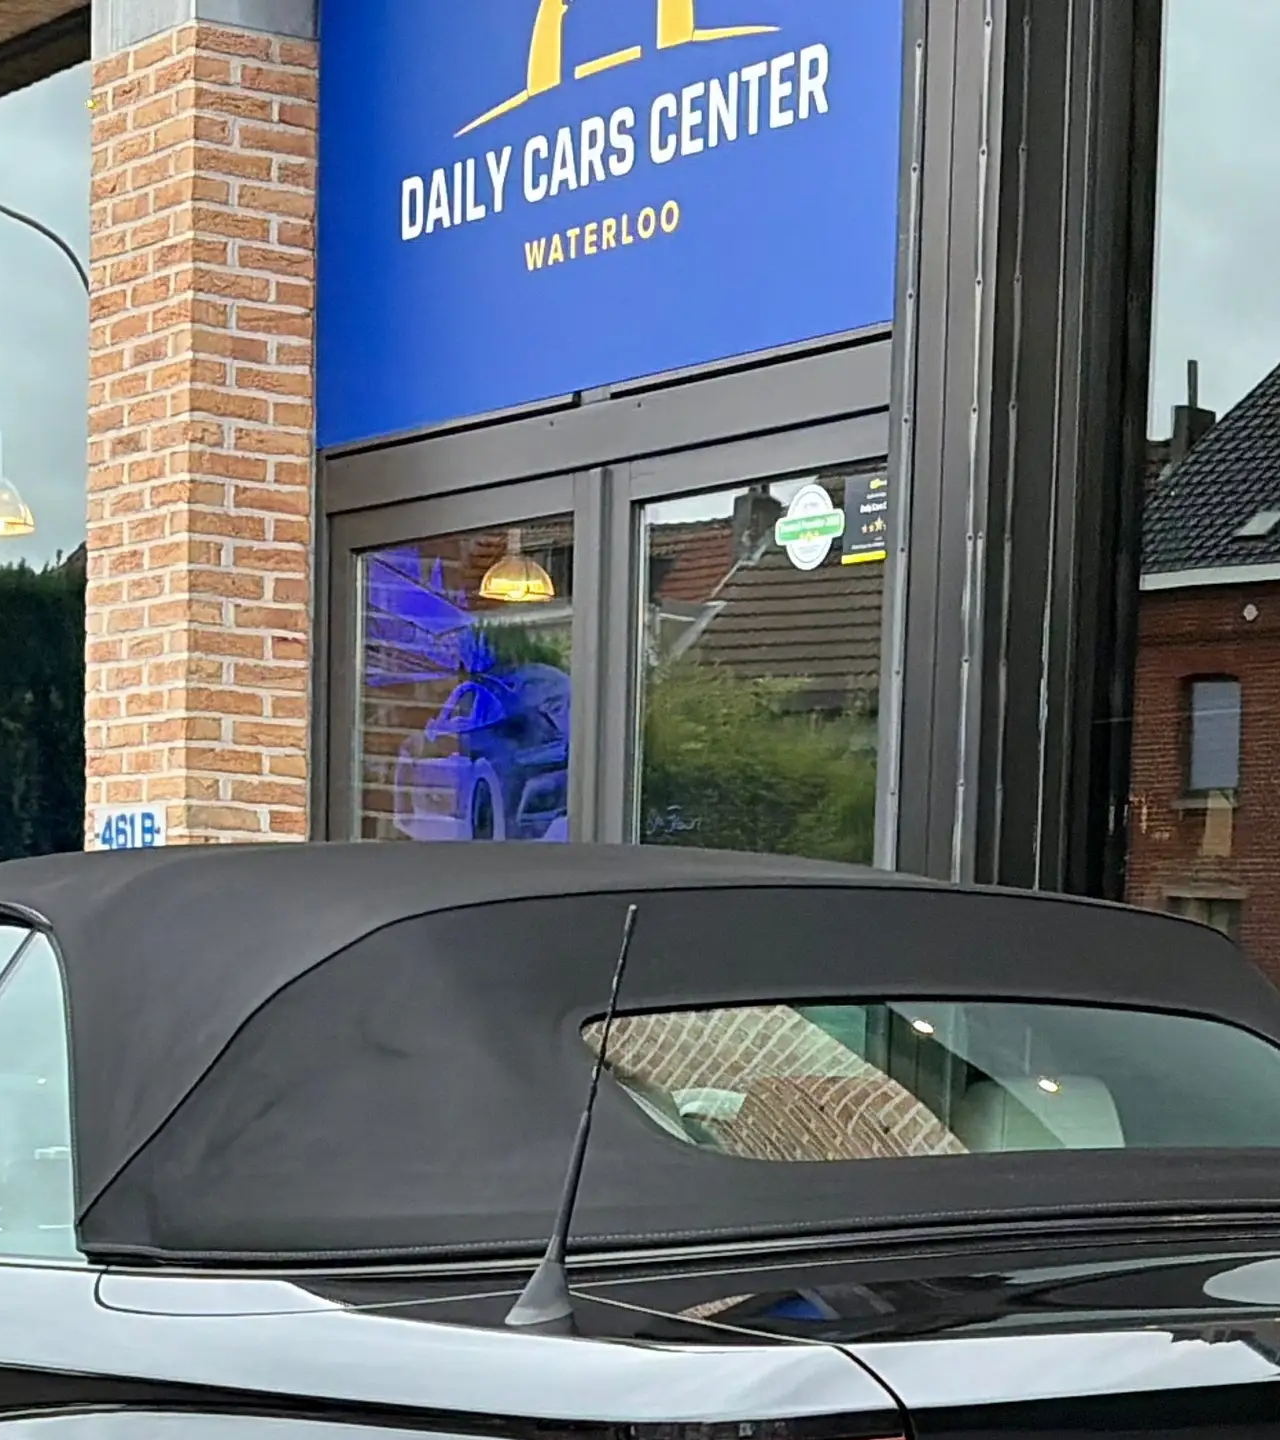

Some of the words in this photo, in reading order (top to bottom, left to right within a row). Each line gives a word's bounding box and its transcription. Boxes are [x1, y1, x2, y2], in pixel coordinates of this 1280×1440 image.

[401, 145, 512, 241] DAILY
[523, 106, 636, 203] CARS
[650, 43, 829, 165] CENTER
[524, 199, 681, 271] WATERLOO
